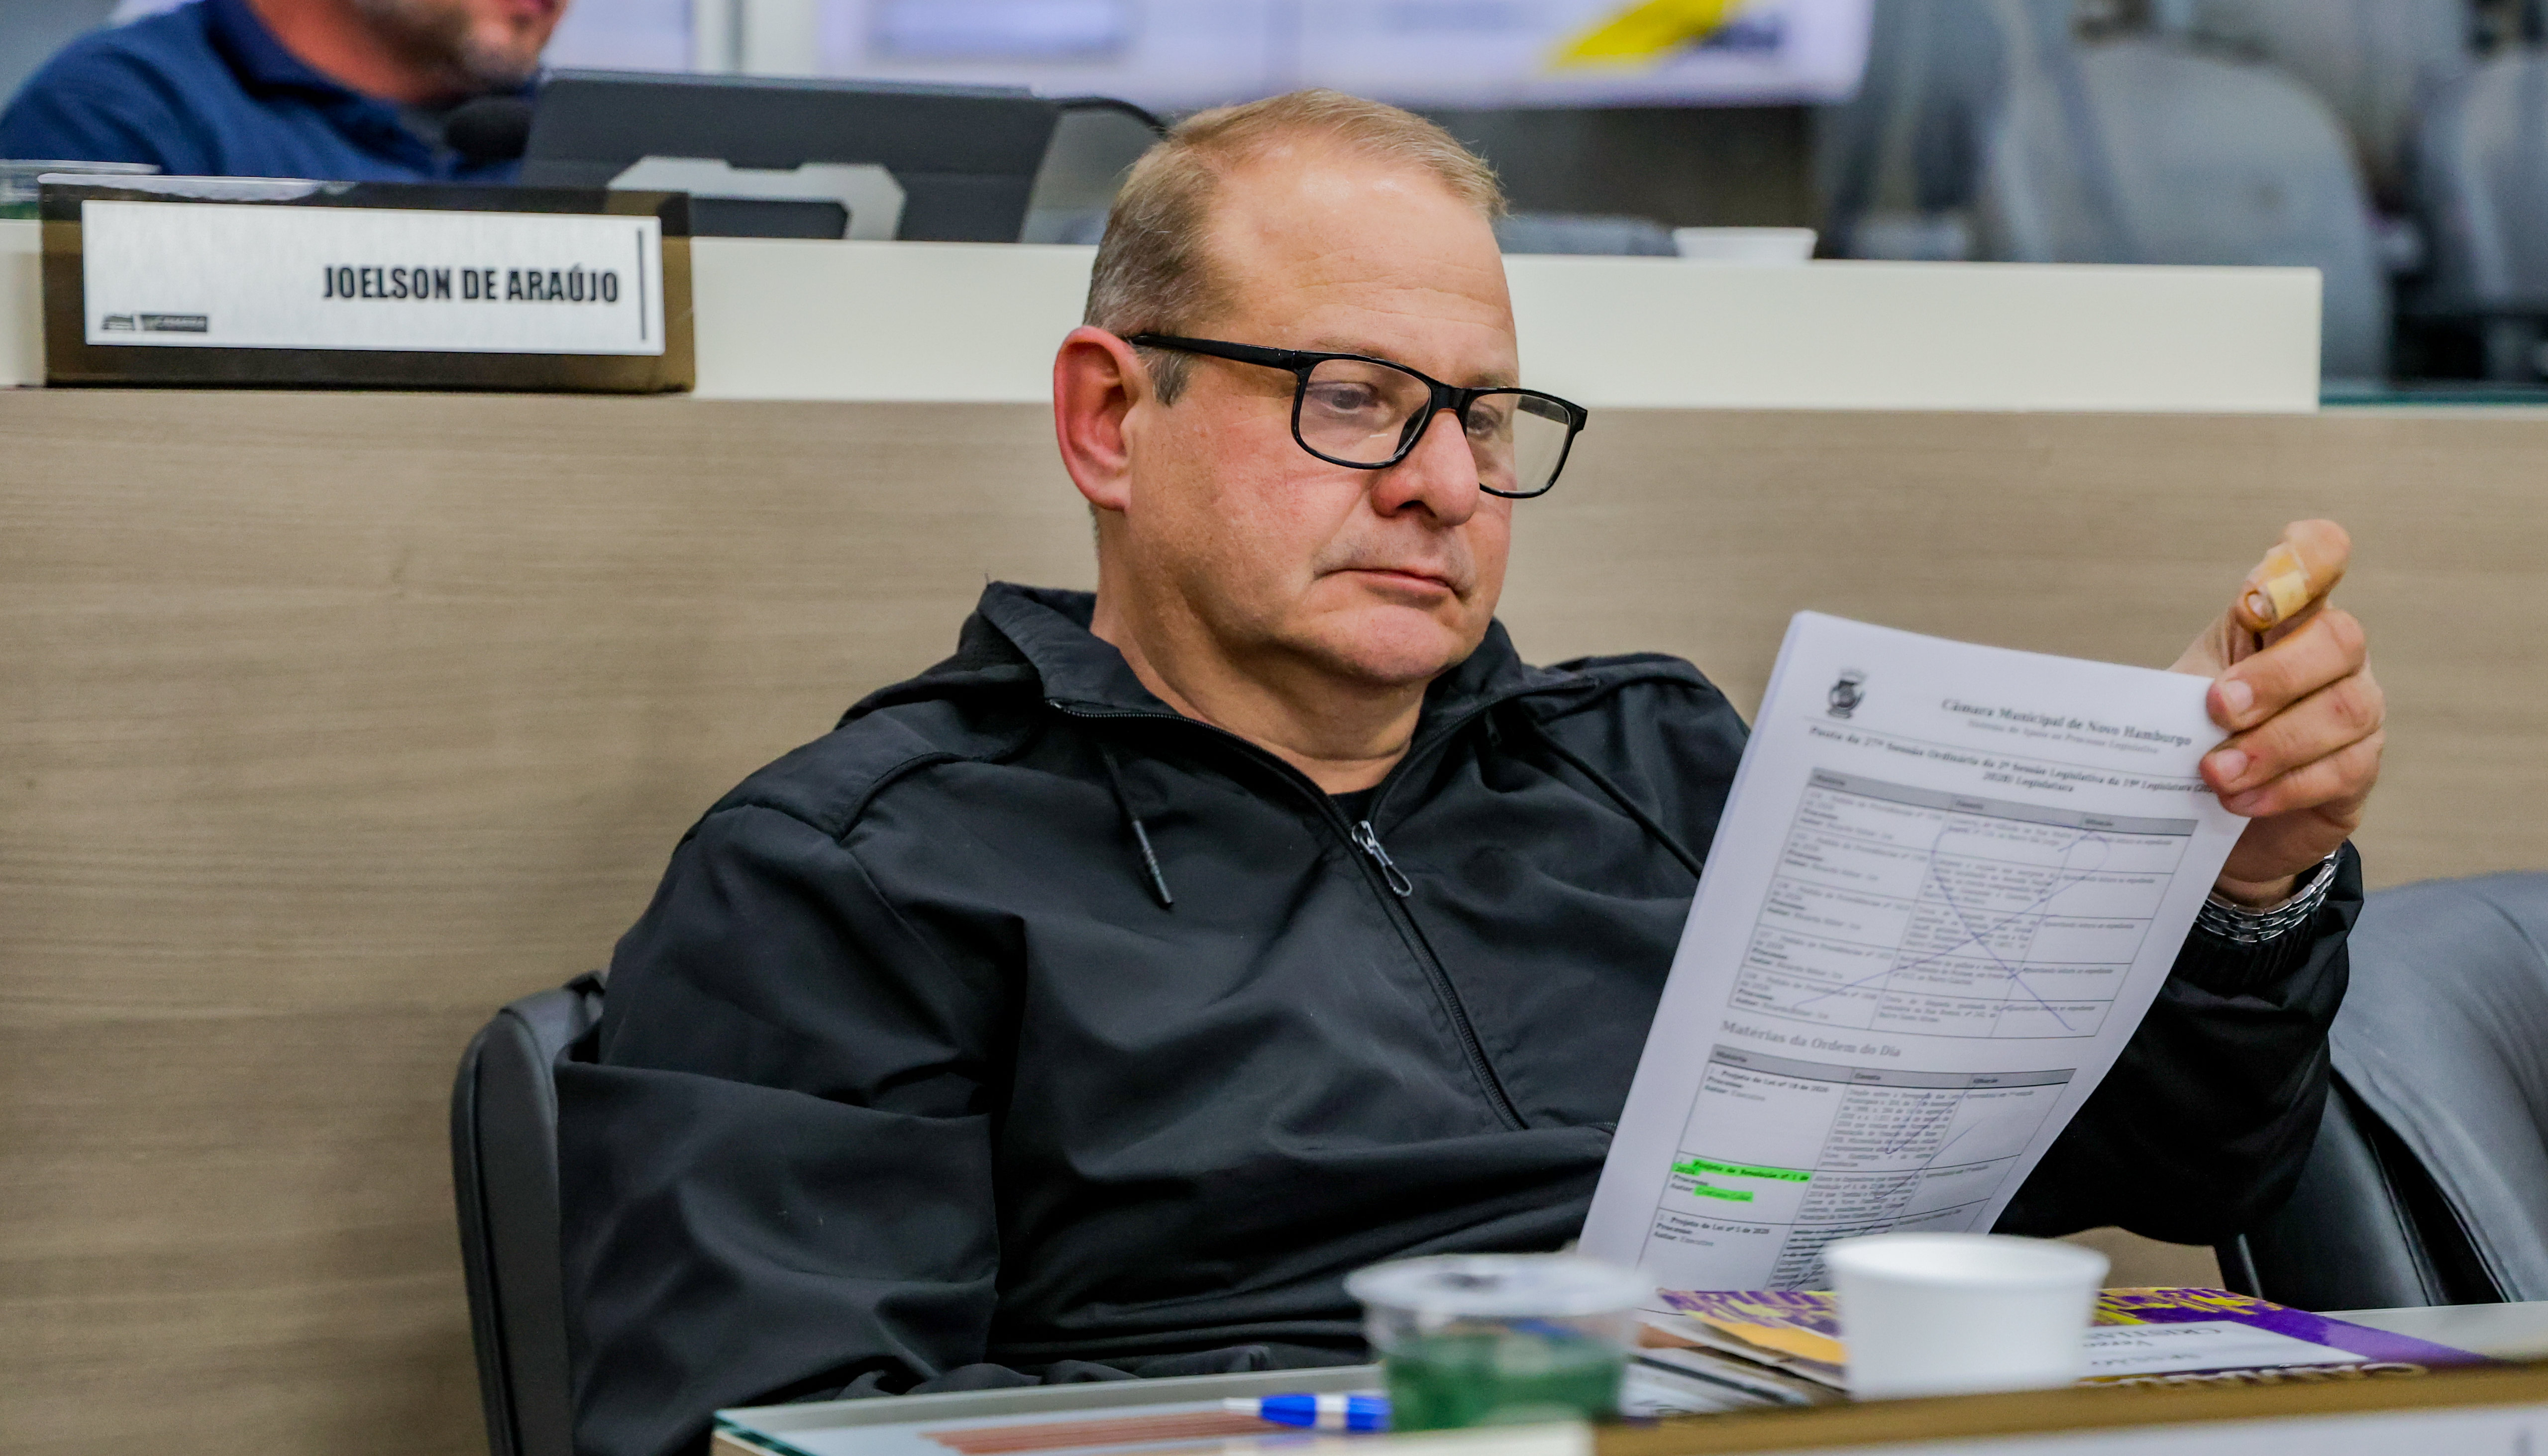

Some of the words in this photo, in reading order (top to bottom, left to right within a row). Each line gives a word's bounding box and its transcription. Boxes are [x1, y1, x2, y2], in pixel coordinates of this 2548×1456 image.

[324, 266, 451, 299] JOELSON
[462, 270, 498, 300] DE
[508, 262, 619, 303] ARAÚJO
[1942, 698, 1994, 716] Câmara
[2000, 708, 2065, 727] Municipal
[2067, 718, 2083, 729] de
[2089, 721, 2119, 735] Novo
[2124, 726, 2192, 746] Hamburgo
[1720, 1019, 1786, 1043] Matérias
[1789, 1035, 1807, 1046] da
[1810, 1037, 1857, 1053] Ordem
[1859, 1043, 1877, 1054] do
[1880, 1045, 1902, 1057] Dia
